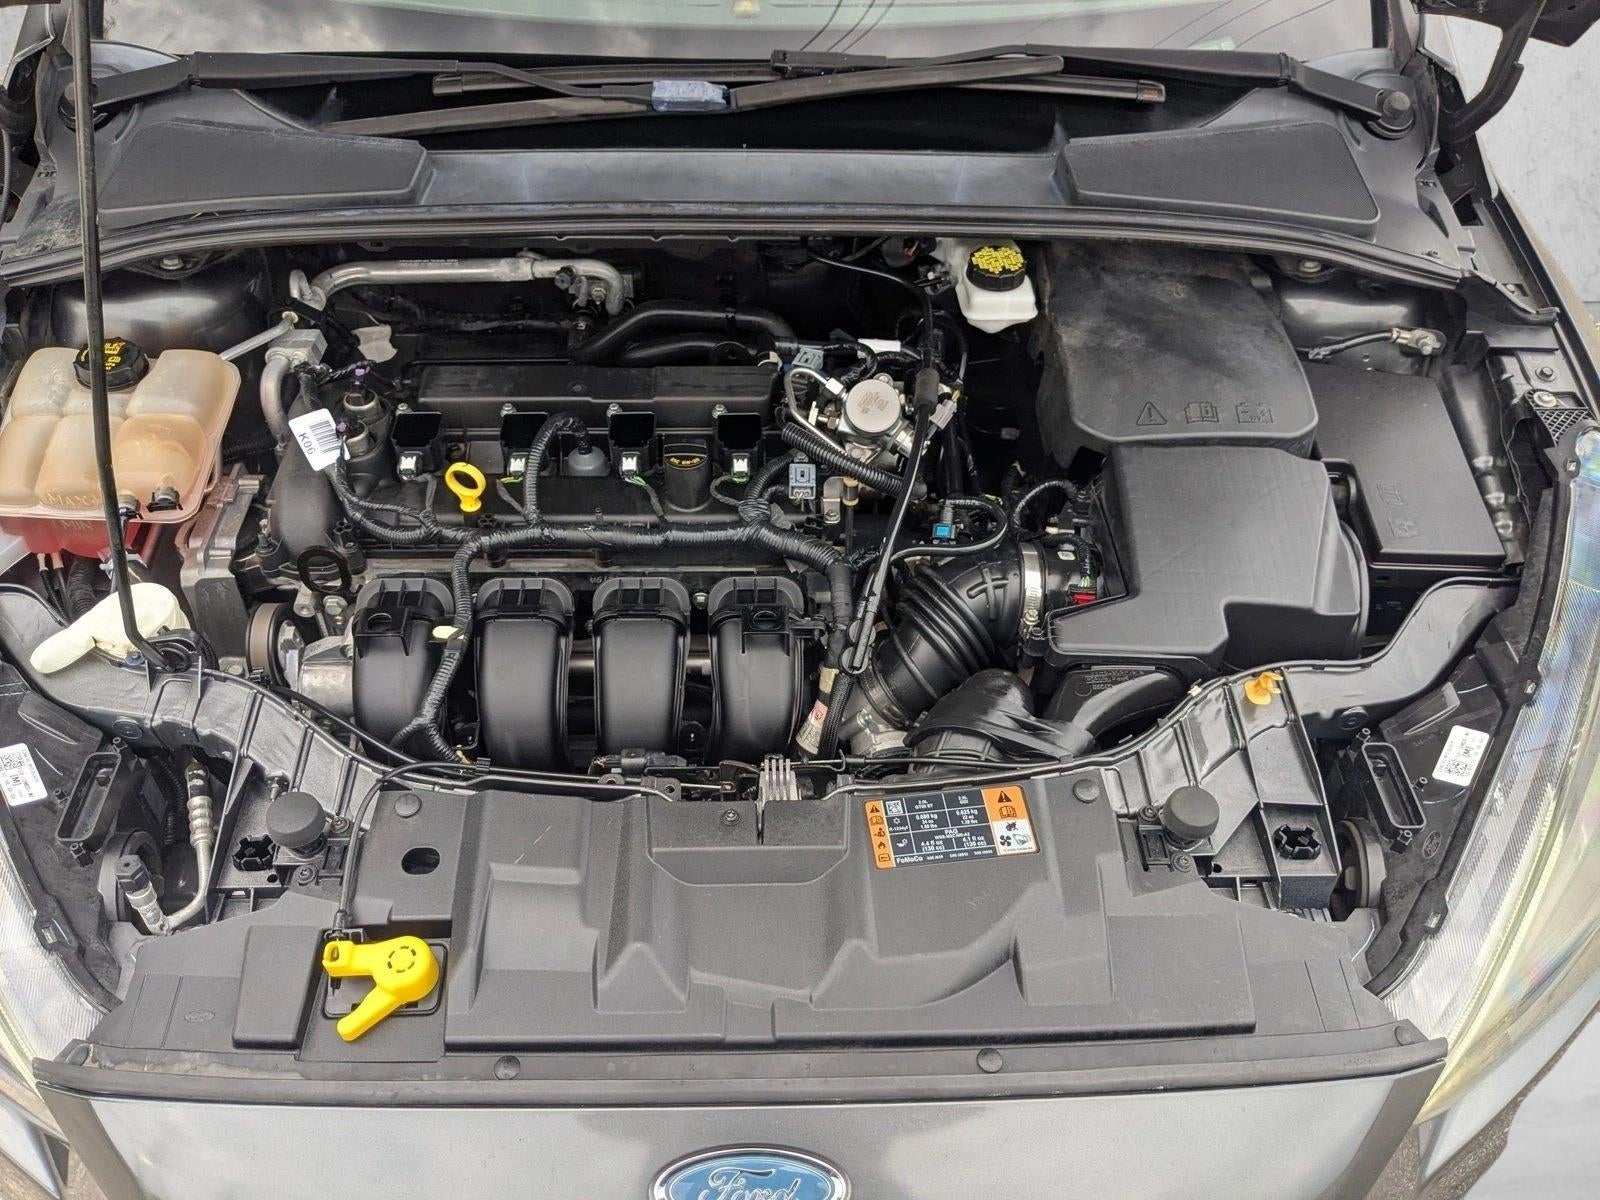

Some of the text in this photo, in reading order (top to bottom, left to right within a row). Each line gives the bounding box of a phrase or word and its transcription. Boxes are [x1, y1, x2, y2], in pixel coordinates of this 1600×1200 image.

[298, 432, 316, 455] K06
[922, 845, 935, 853] (130
[896, 855, 924, 864] FoMoCo
